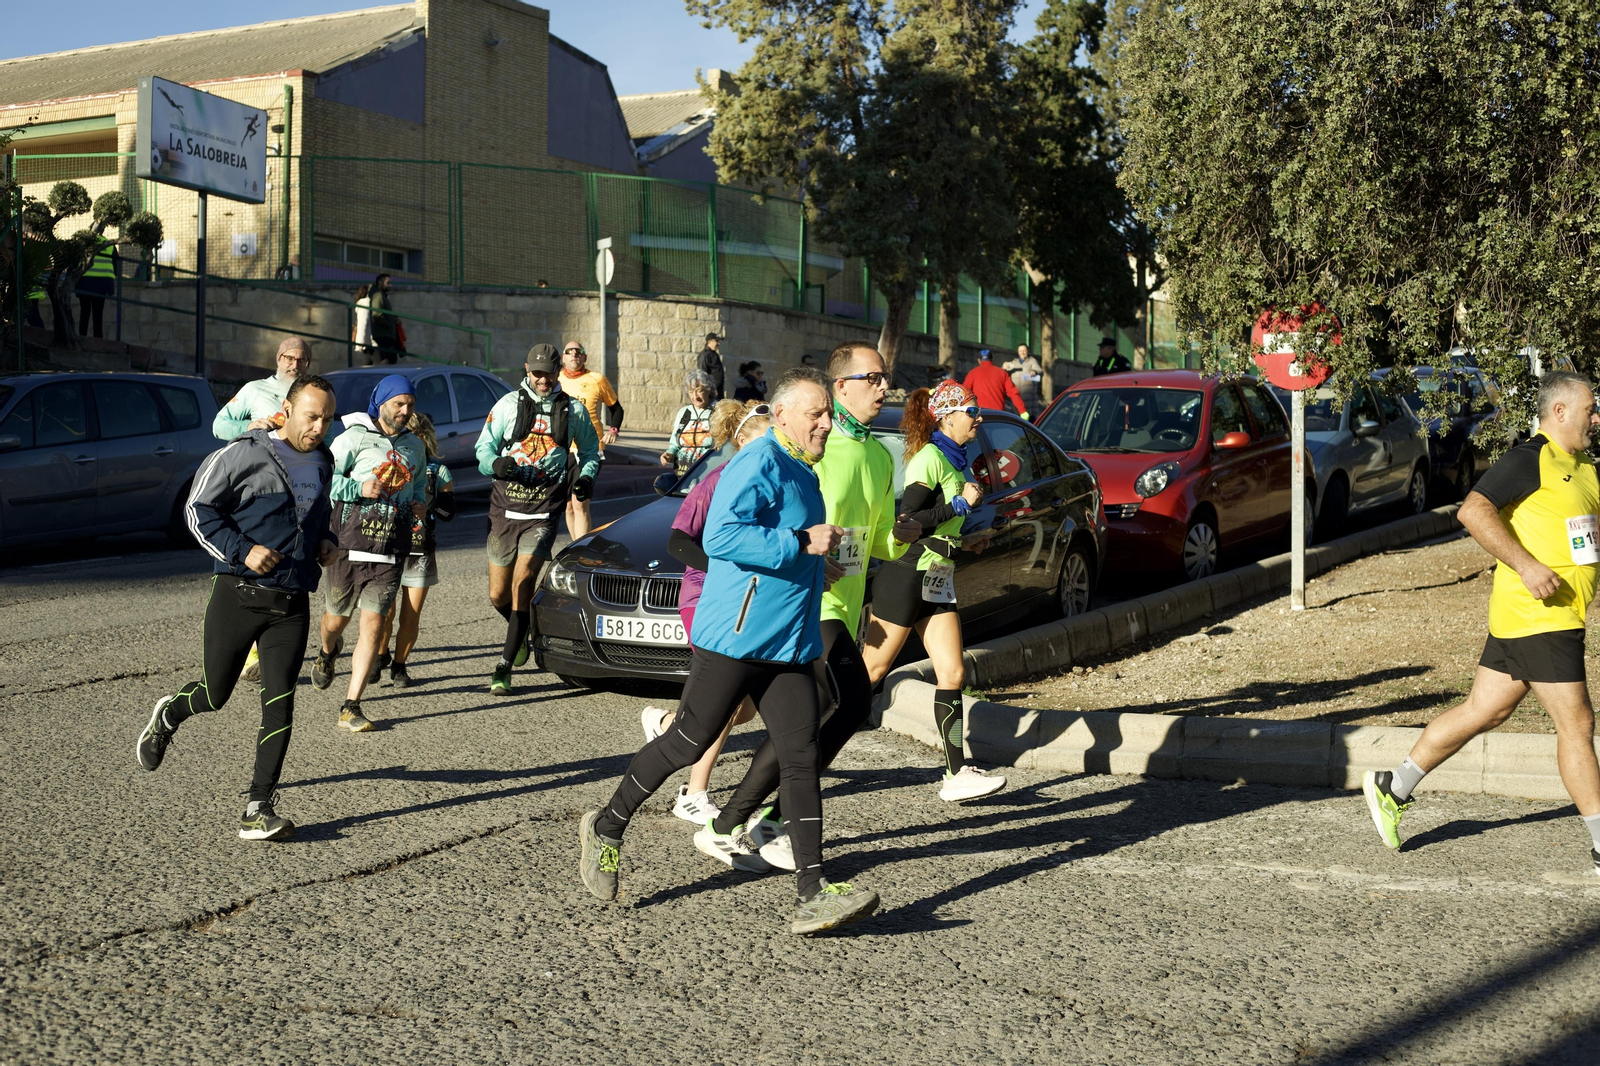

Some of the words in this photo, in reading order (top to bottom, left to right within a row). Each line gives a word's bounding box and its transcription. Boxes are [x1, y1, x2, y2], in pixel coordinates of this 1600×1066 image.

[169, 132, 183, 153] LA
[186, 137, 248, 170] SALOBREJA
[846, 543, 859, 558] 12
[606, 618, 645, 638] 5812
[651, 622, 684, 641] GCG
